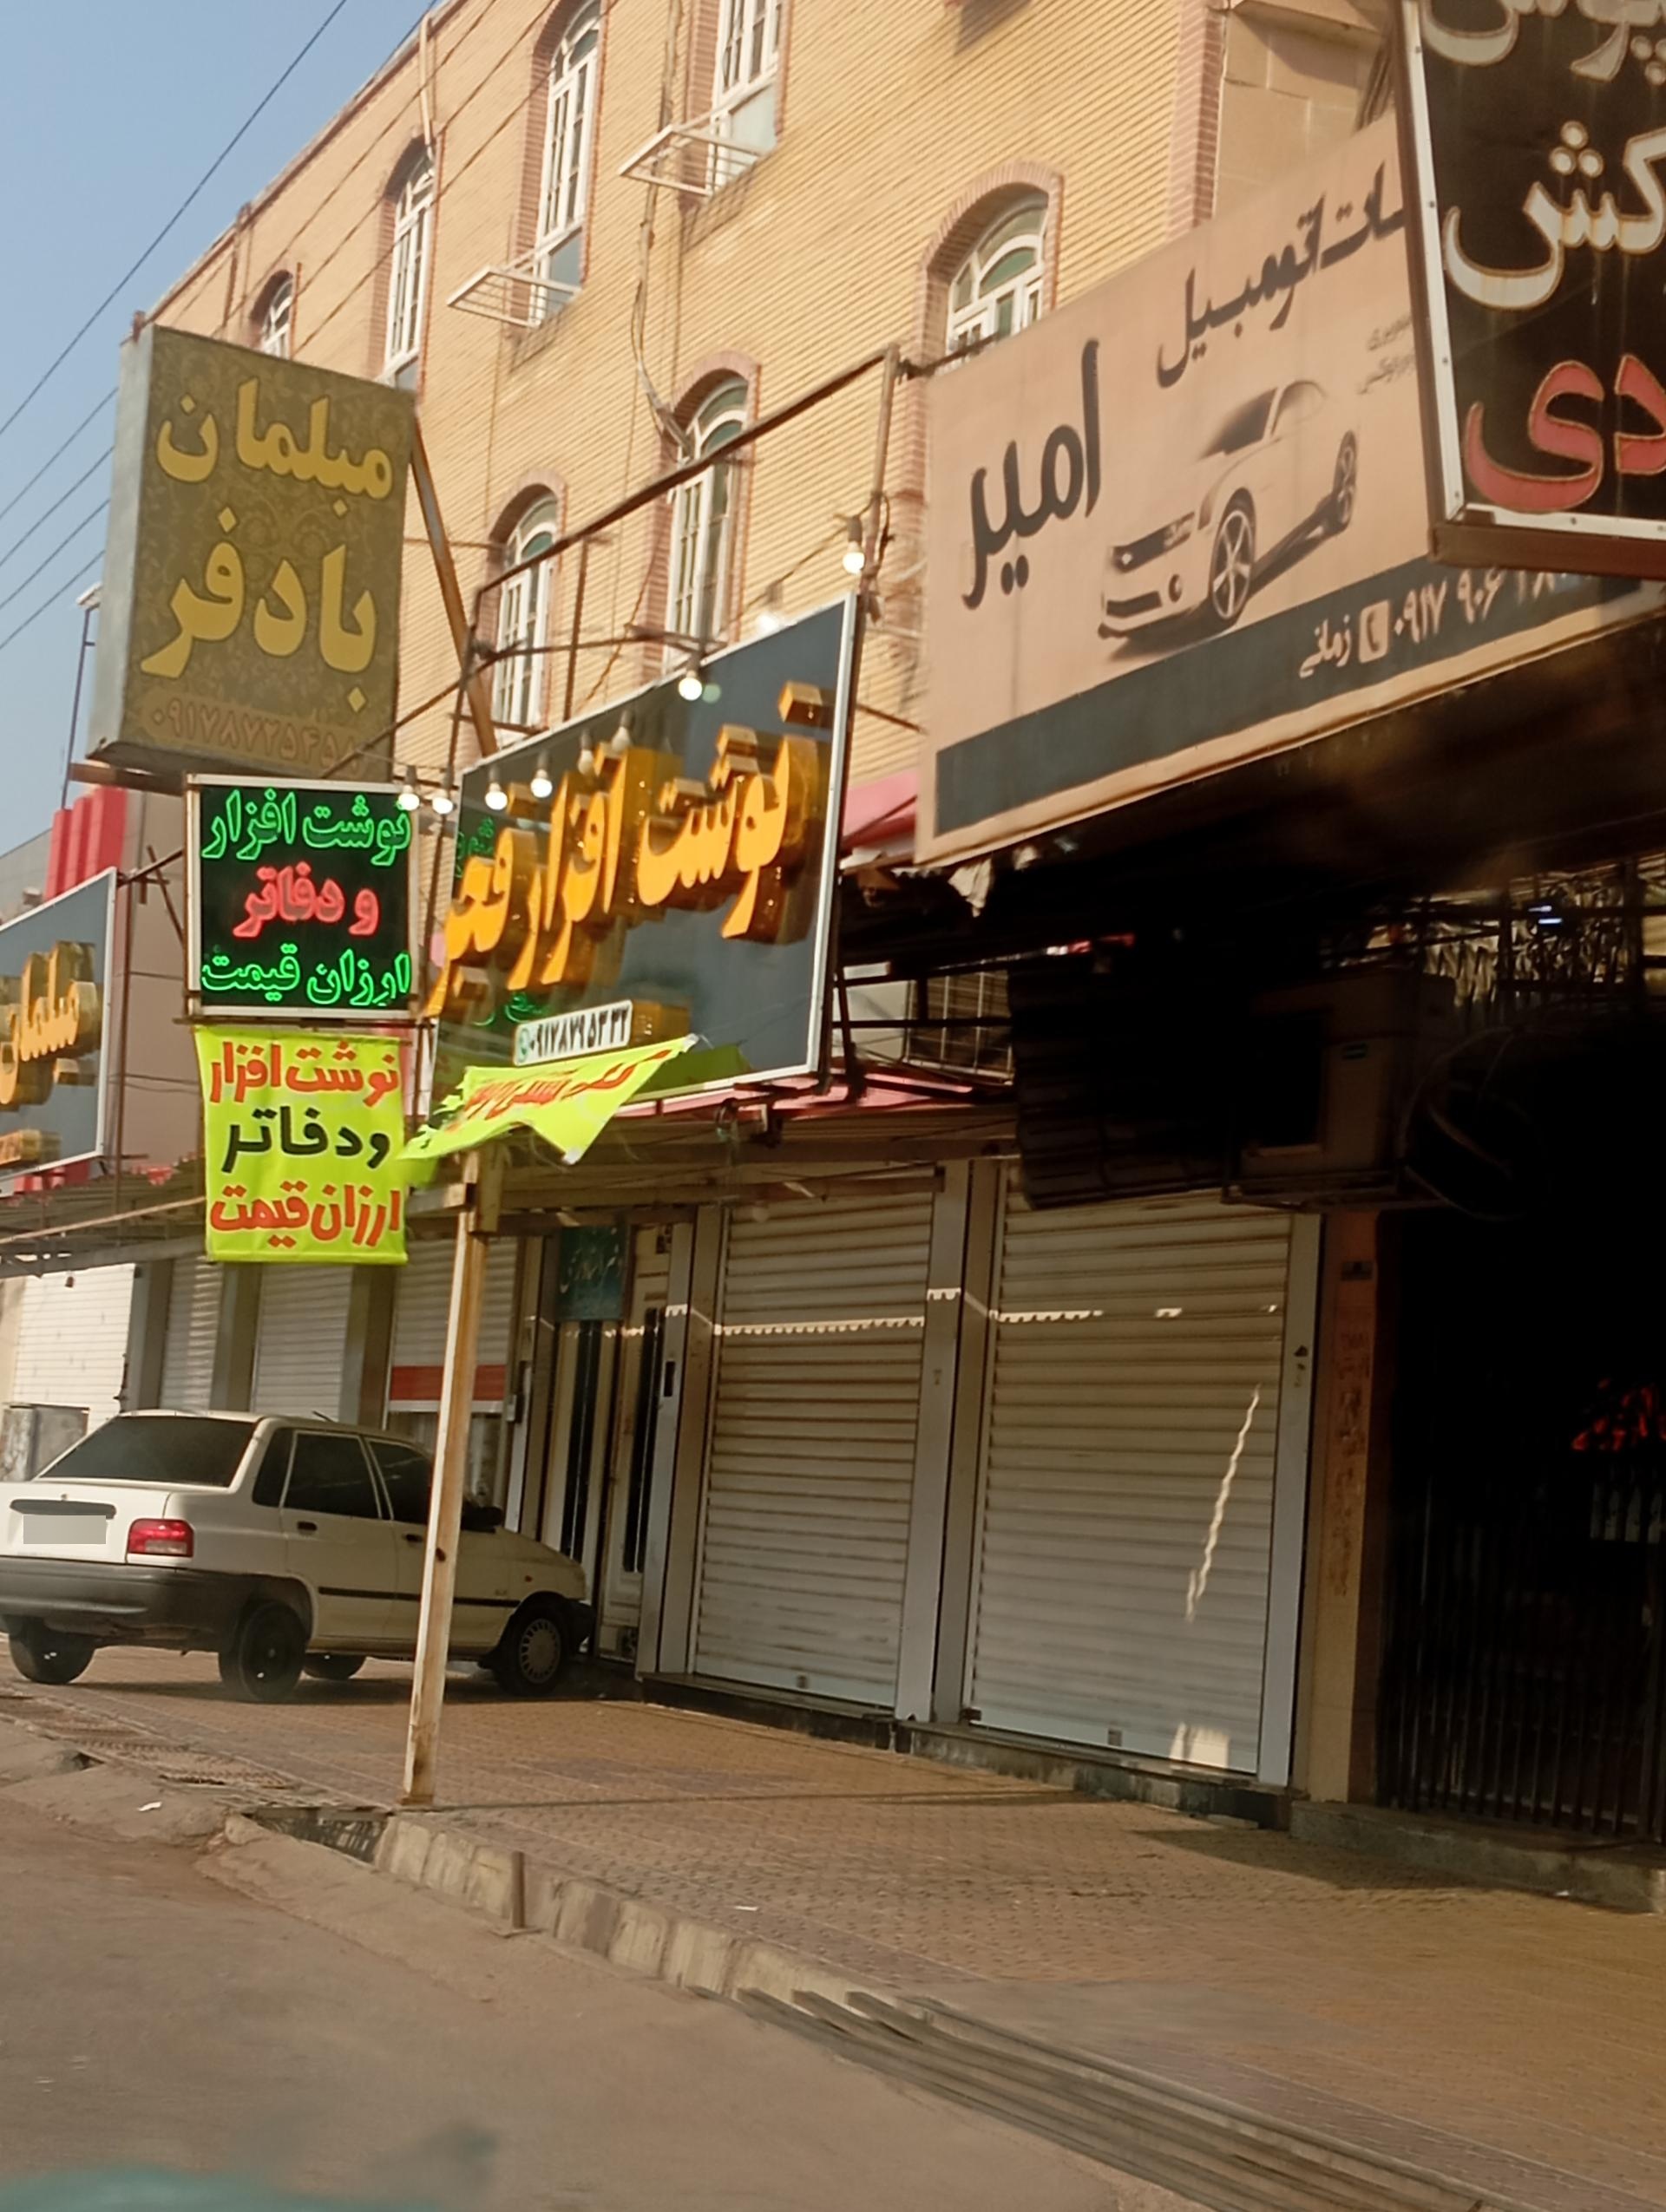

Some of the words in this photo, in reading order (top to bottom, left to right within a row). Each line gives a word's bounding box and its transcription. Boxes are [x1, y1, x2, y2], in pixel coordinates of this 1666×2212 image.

[1156, 189, 1327, 389] اتومبیل
[156, 377, 393, 517] مبلمان
[961, 339, 1101, 610] امیر
[140, 507, 377, 713] بادفر
[200, 787, 297, 861] افزار
[303, 794, 411, 866] نوشت
[636, 681, 803, 939] نوشت
[232, 861, 346, 938] دفاتر
[507, 743, 632, 991] افزار
[348, 887, 380, 936] و
[200, 942, 301, 1002] قیمت
[306, 948, 411, 1006] ارزان
[209, 1041, 282, 1104] افزار
[285, 1040, 399, 1108] نوشت
[209, 1180, 311, 1248] قیمت
[311, 1183, 401, 1247] ارزان
